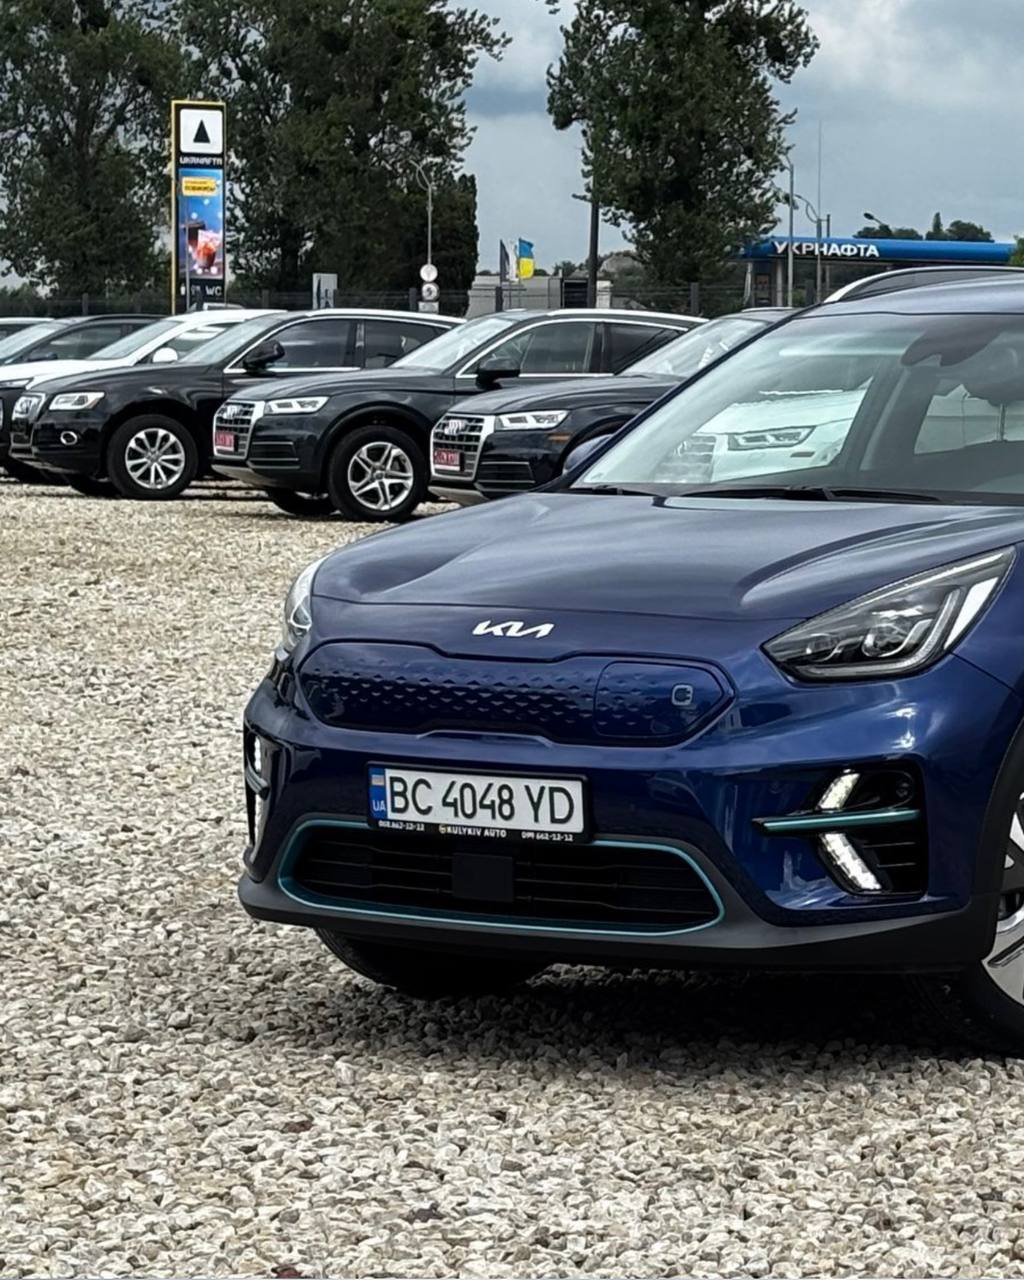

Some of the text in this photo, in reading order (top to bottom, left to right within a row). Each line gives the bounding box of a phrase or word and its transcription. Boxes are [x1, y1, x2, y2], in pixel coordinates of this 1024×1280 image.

[774, 241, 880, 258] УКРНАФТА
[205, 285, 222, 296] WC
[472, 620, 554, 638] KIA
[373, 801, 386, 812] UA
[389, 776, 574, 824] BC 4048 YD
[484, 829, 507, 838] AUTO
